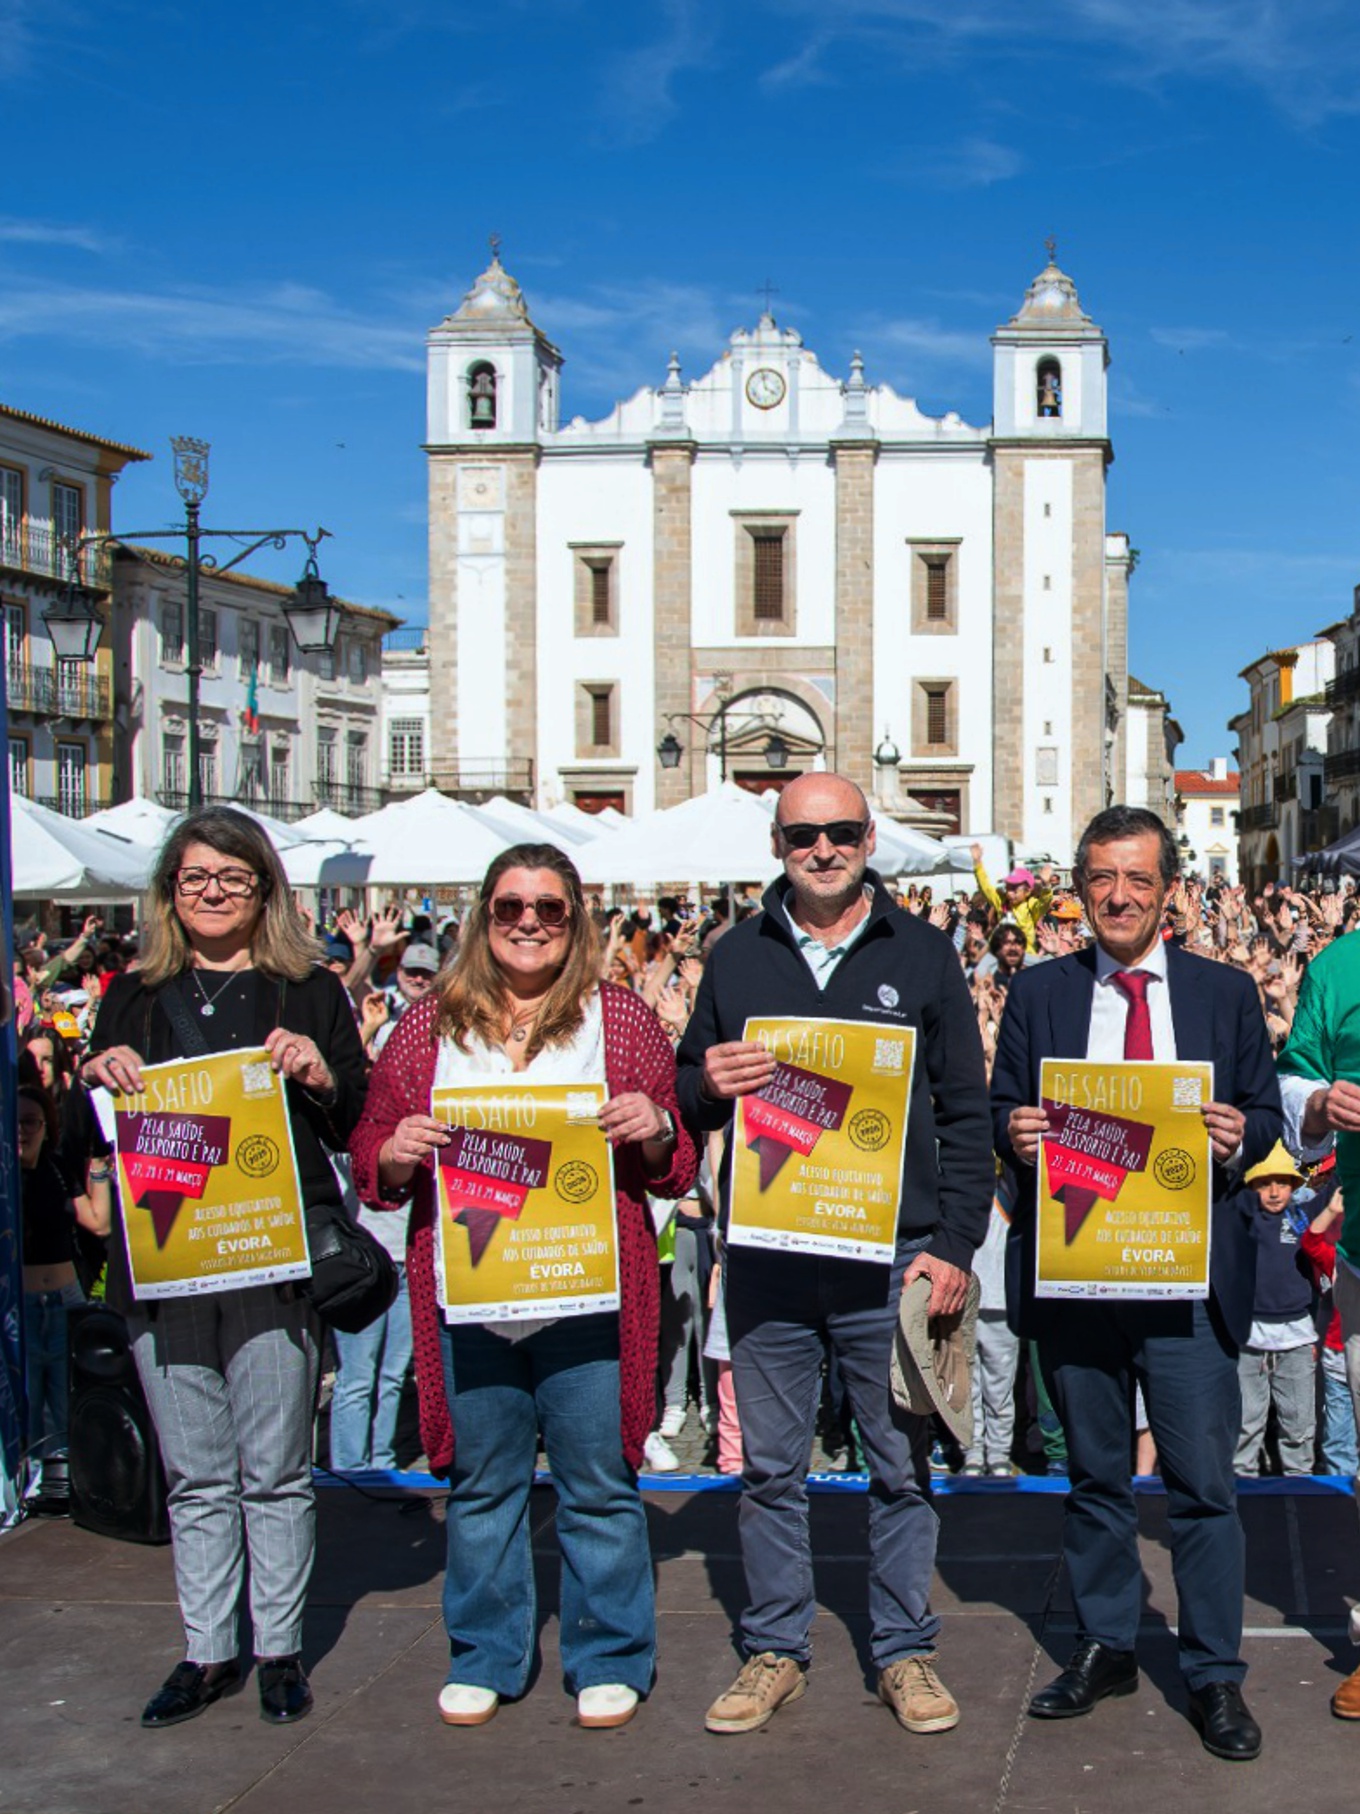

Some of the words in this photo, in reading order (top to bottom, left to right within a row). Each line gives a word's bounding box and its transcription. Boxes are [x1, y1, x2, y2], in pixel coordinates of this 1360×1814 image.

[774, 1067, 791, 1088] ELA
[125, 1071, 213, 1119] DESAFIO
[1054, 1074, 1142, 1112] DESAFIO
[445, 1093, 537, 1132] DESAFIO
[758, 1085, 808, 1116] DESPORTO
[816, 1106, 838, 1128] PAZ
[140, 1118, 164, 1136] PELA
[1065, 1112, 1090, 1132] PELA
[136, 1136, 189, 1159] DESPORTO
[201, 1146, 222, 1164] PAZ
[462, 1133, 487, 1153] PELA
[1060, 1127, 1110, 1159] DESPORTO
[1120, 1148, 1141, 1170] PAZ
[457, 1150, 510, 1179] DESPORTO
[521, 1166, 542, 1187] PAZ
[815, 1200, 866, 1220] ÉVORA
[217, 1235, 272, 1254] ÉVORA
[1122, 1246, 1175, 1262] ÉVORA
[530, 1262, 585, 1279] ÉVORA
